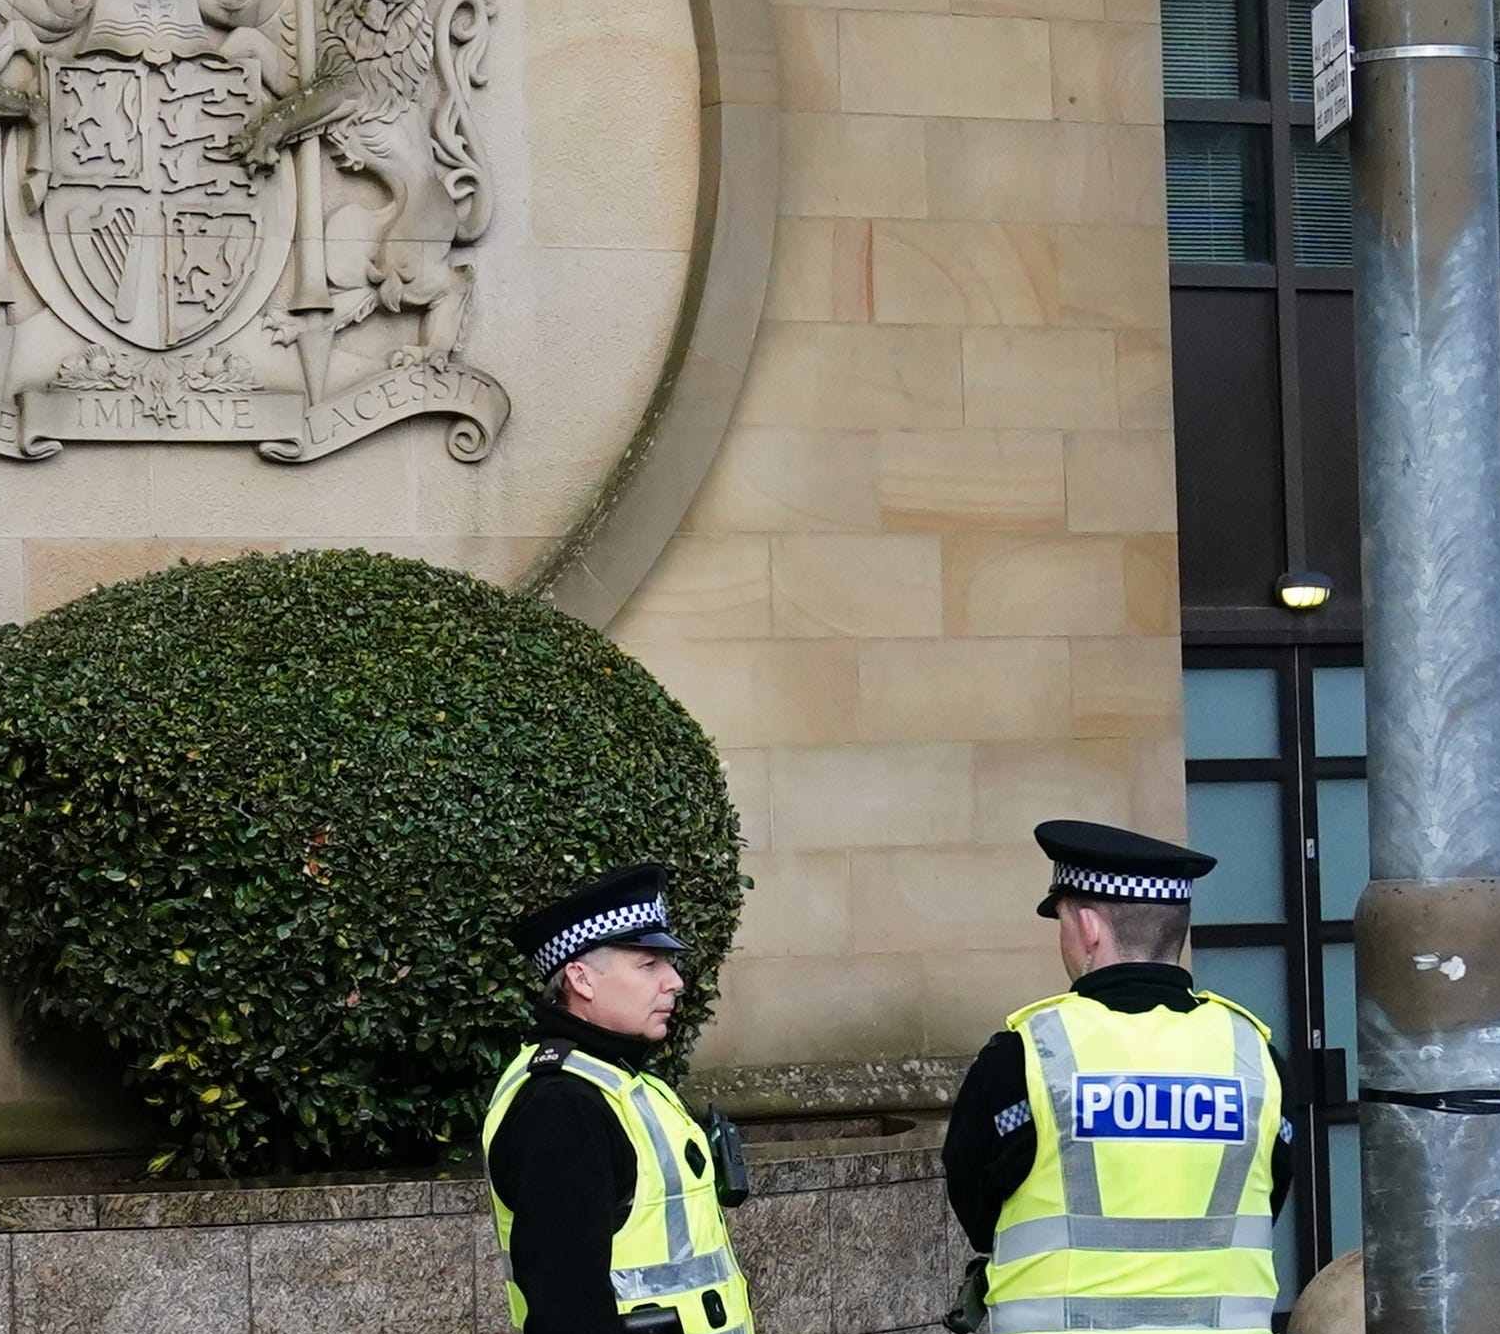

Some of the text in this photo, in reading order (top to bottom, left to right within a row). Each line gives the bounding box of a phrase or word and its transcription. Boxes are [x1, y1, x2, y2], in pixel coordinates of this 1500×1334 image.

[1316, 86, 1325, 104] No
[304, 369, 492, 446] LACESSIT
[1082, 1083, 1239, 1132] POLICE
